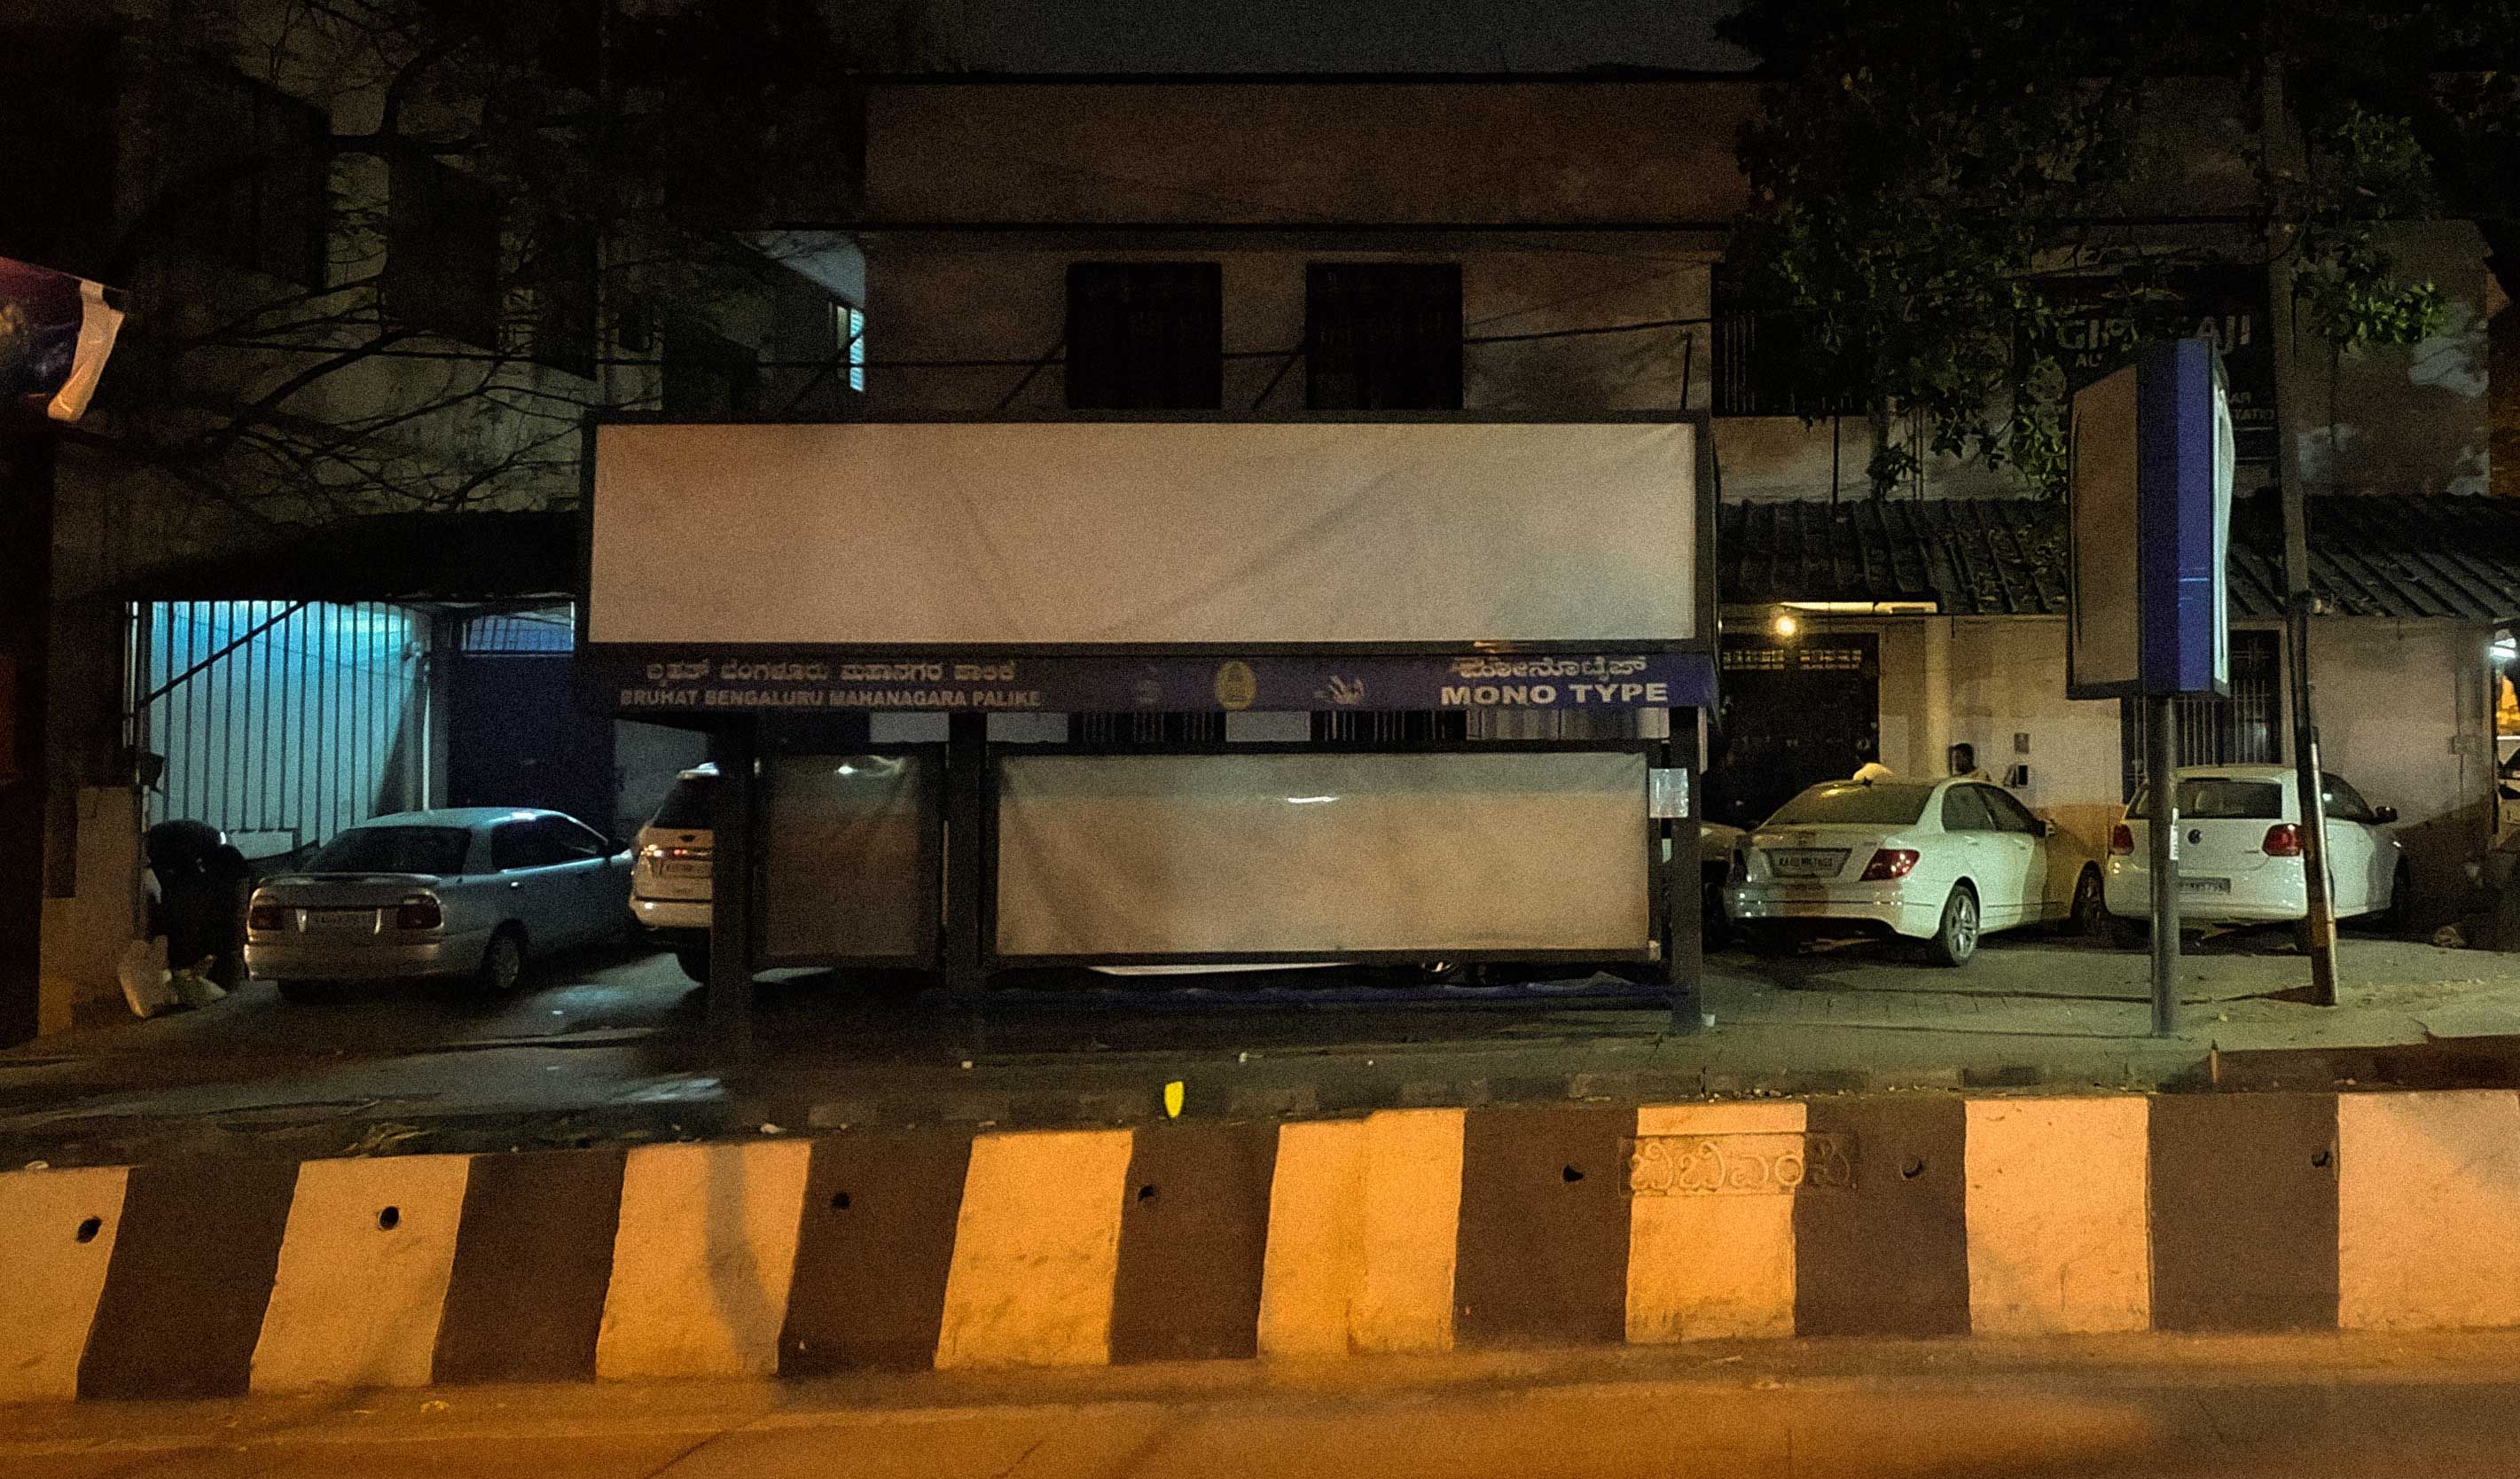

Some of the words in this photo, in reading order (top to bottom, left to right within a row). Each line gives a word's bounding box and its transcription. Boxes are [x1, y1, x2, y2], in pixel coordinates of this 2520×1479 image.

[621, 690, 698, 706] BRUHAT
[704, 690, 825, 706] BENGALURU
[829, 690, 967, 707] MAHANAGARA
[973, 691, 1041, 707] PALIKE
[1440, 685, 1557, 705] MONO
[1568, 683, 1669, 703] TYPE
